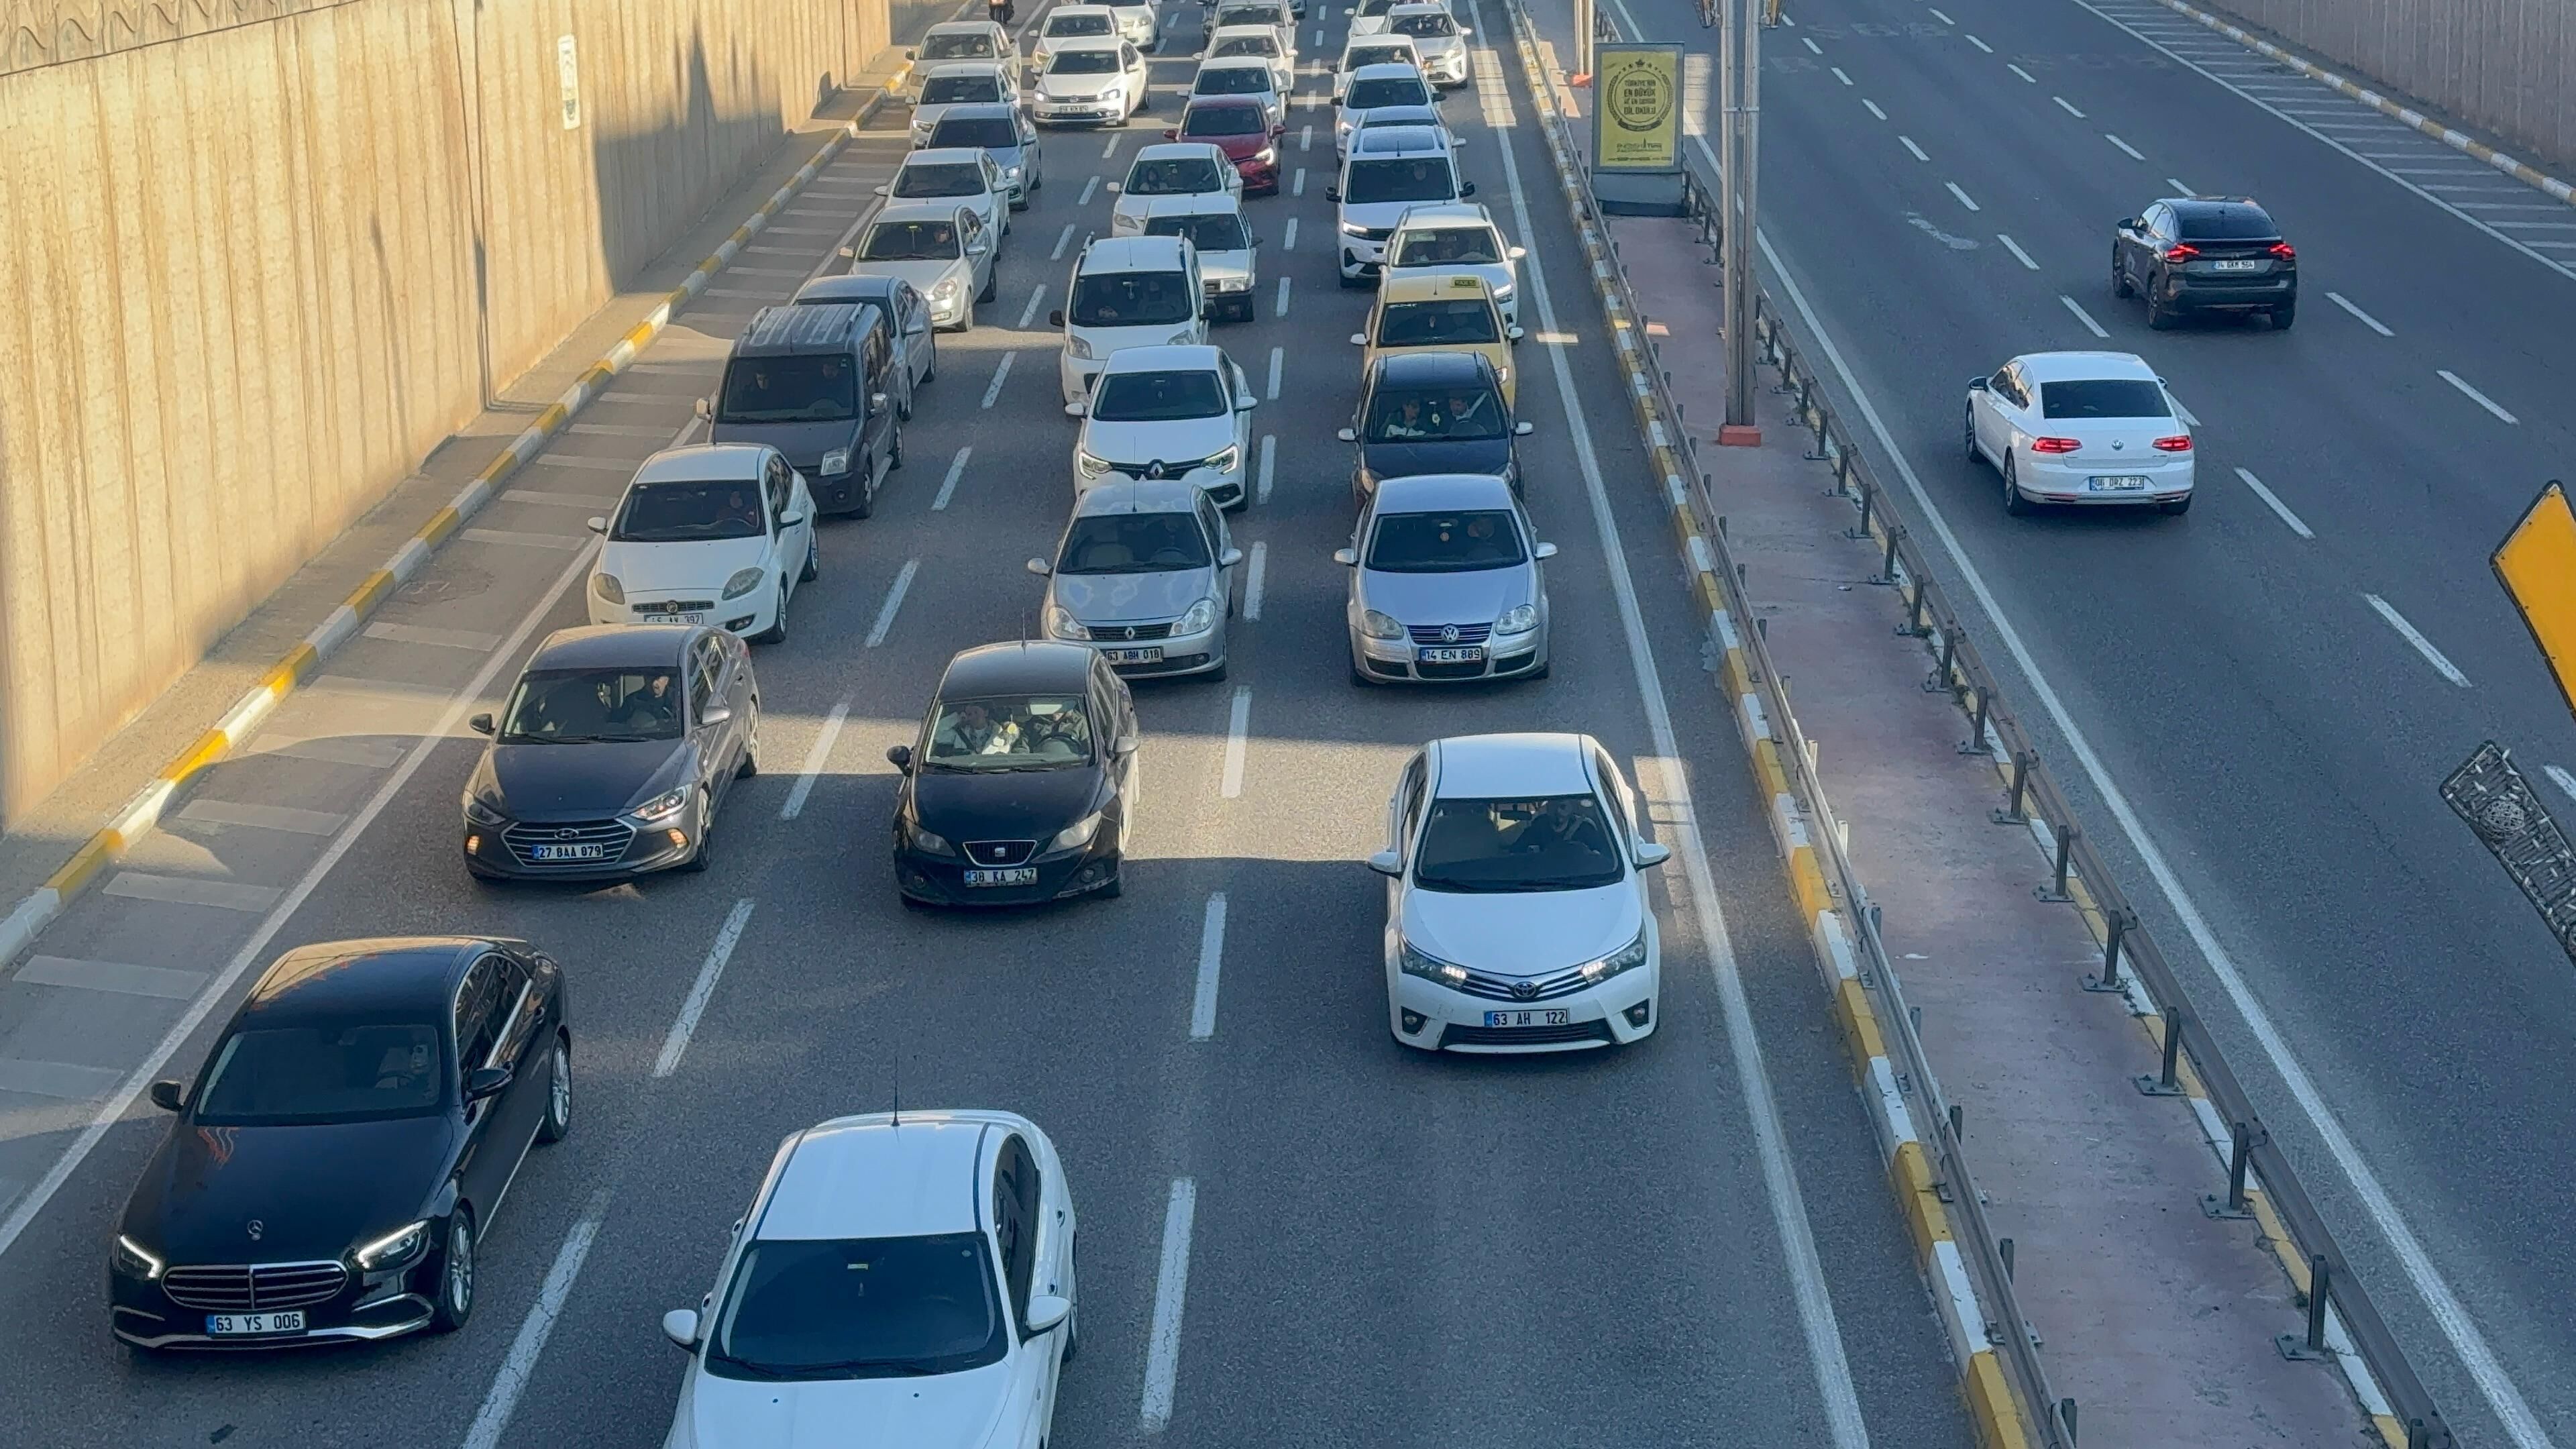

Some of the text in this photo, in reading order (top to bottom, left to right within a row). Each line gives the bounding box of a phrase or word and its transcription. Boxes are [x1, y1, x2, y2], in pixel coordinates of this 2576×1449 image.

[1426, 650, 1437, 659] 14
[1442, 649, 1456, 659] EN
[539, 847, 551, 858] 27
[993, 871, 1006, 882] KA
[1493, 1011, 1566, 1026] 63 AH 122
[215, 1313, 301, 1331] 63 YS 006
